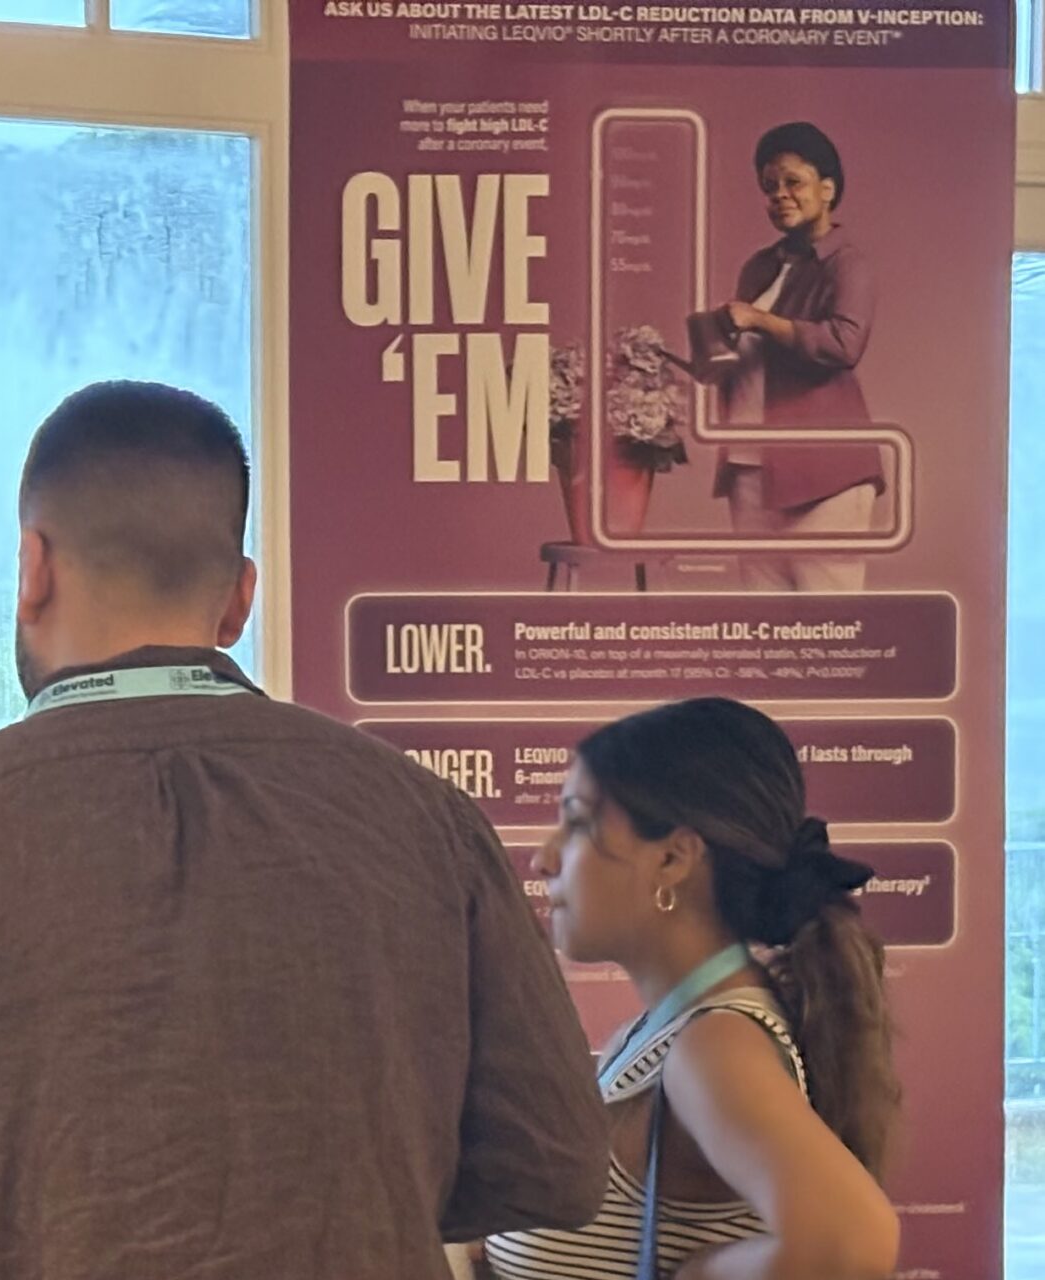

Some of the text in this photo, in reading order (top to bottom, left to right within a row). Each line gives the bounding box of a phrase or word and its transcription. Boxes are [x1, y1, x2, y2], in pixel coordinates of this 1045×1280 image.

[324, 1, 985, 25] ASK US ABOUT THE LATEST LDL-C REDUCTION DATA FROM V-INCEPTION:
[409, 24, 498, 40] INITIATING
[577, 26, 654, 43] SHORTLY
[658, 28, 712, 44] AFTER
[717, 28, 729, 44] A
[732, 28, 830, 45] CORONARY
[468, 101, 516, 115] patients
[446, 118, 477, 135] fight
[479, 118, 509, 135] high
[511, 118, 549, 132] LDL-C
[457, 139, 509, 153] coronary
[341, 171, 550, 327] GIVE
[514, 621, 591, 641] Powerful
[593, 621, 627, 641] and
[629, 621, 718, 641] consistent
[722, 621, 771, 640] LDL-C
[386, 622, 493, 675] LOWER.
[52, 673, 115, 697] Elevated
[514, 748, 569, 765] LEQVIO
[810, 745, 848, 762] lasts
[851, 744, 913, 765] through
